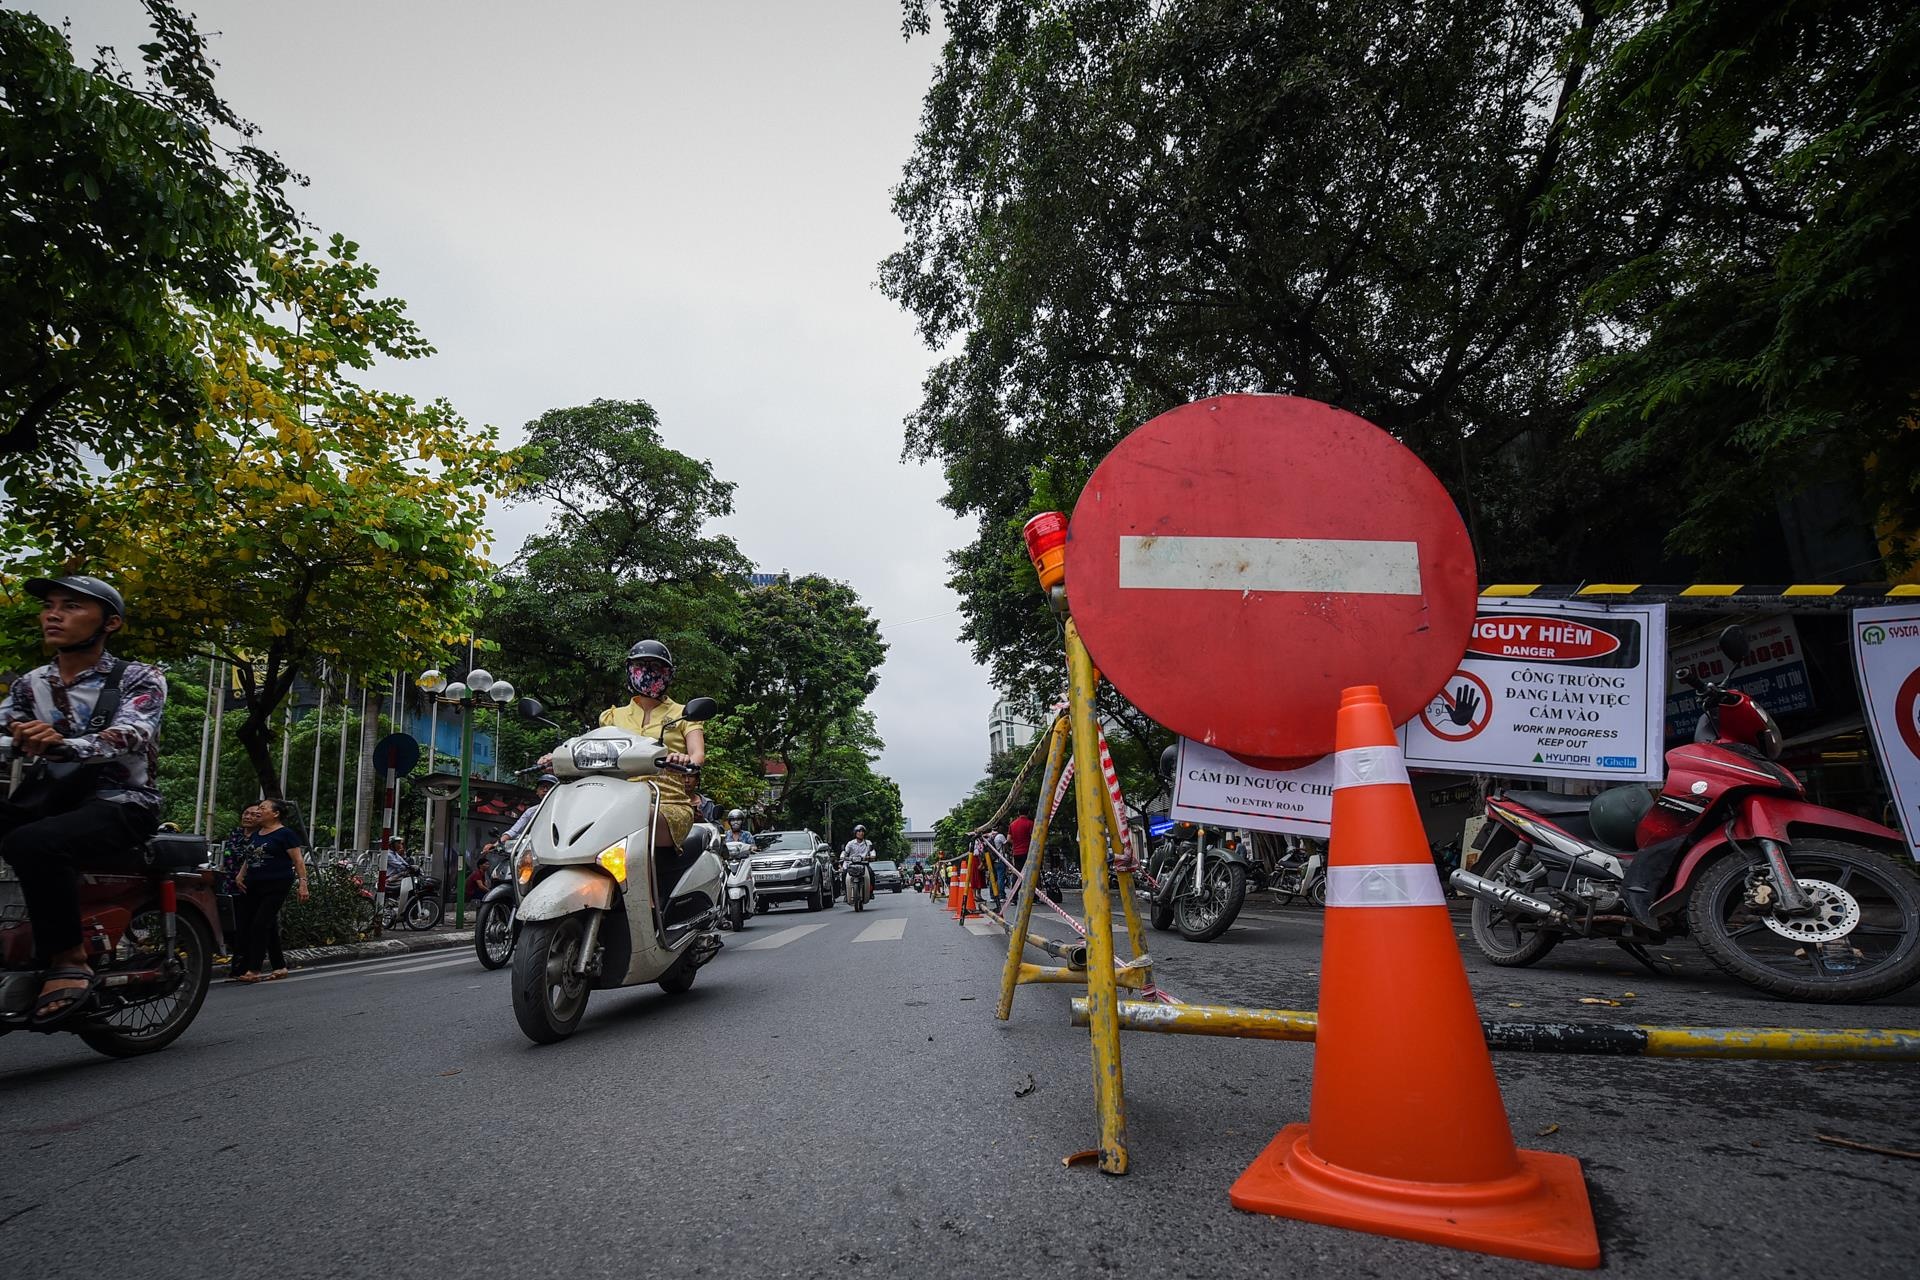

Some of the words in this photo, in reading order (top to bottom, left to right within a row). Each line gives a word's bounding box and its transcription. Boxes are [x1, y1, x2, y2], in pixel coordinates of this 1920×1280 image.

[1888, 624, 1919, 639] SYSTRA
[1503, 645, 1556, 658] DANGER
[1511, 667, 1554, 685] CÔNG
[1558, 673, 1626, 689] TRƯỜNG
[1506, 687, 1549, 702] ĐANG
[1552, 688, 1584, 704] LÀM
[1588, 693, 1631, 708] VIỆC
[1567, 707, 1600, 722] VÀO
[1513, 723, 1544, 734] WORK
[1545, 726, 1557, 735] IN
[1558, 727, 1619, 739] PROGRESS
[1537, 737, 1565, 747] KEEP
[1566, 739, 1588, 749] OUT
[1545, 753, 1591, 763] HYUNDAI
[1225, 774, 1241, 786] ĐI
[1244, 776, 1298, 794] NGƯỢC
[1226, 795, 1240, 805] NO
[1242, 797, 1275, 809] ENTRY
[1276, 801, 1304, 812] ROAD
